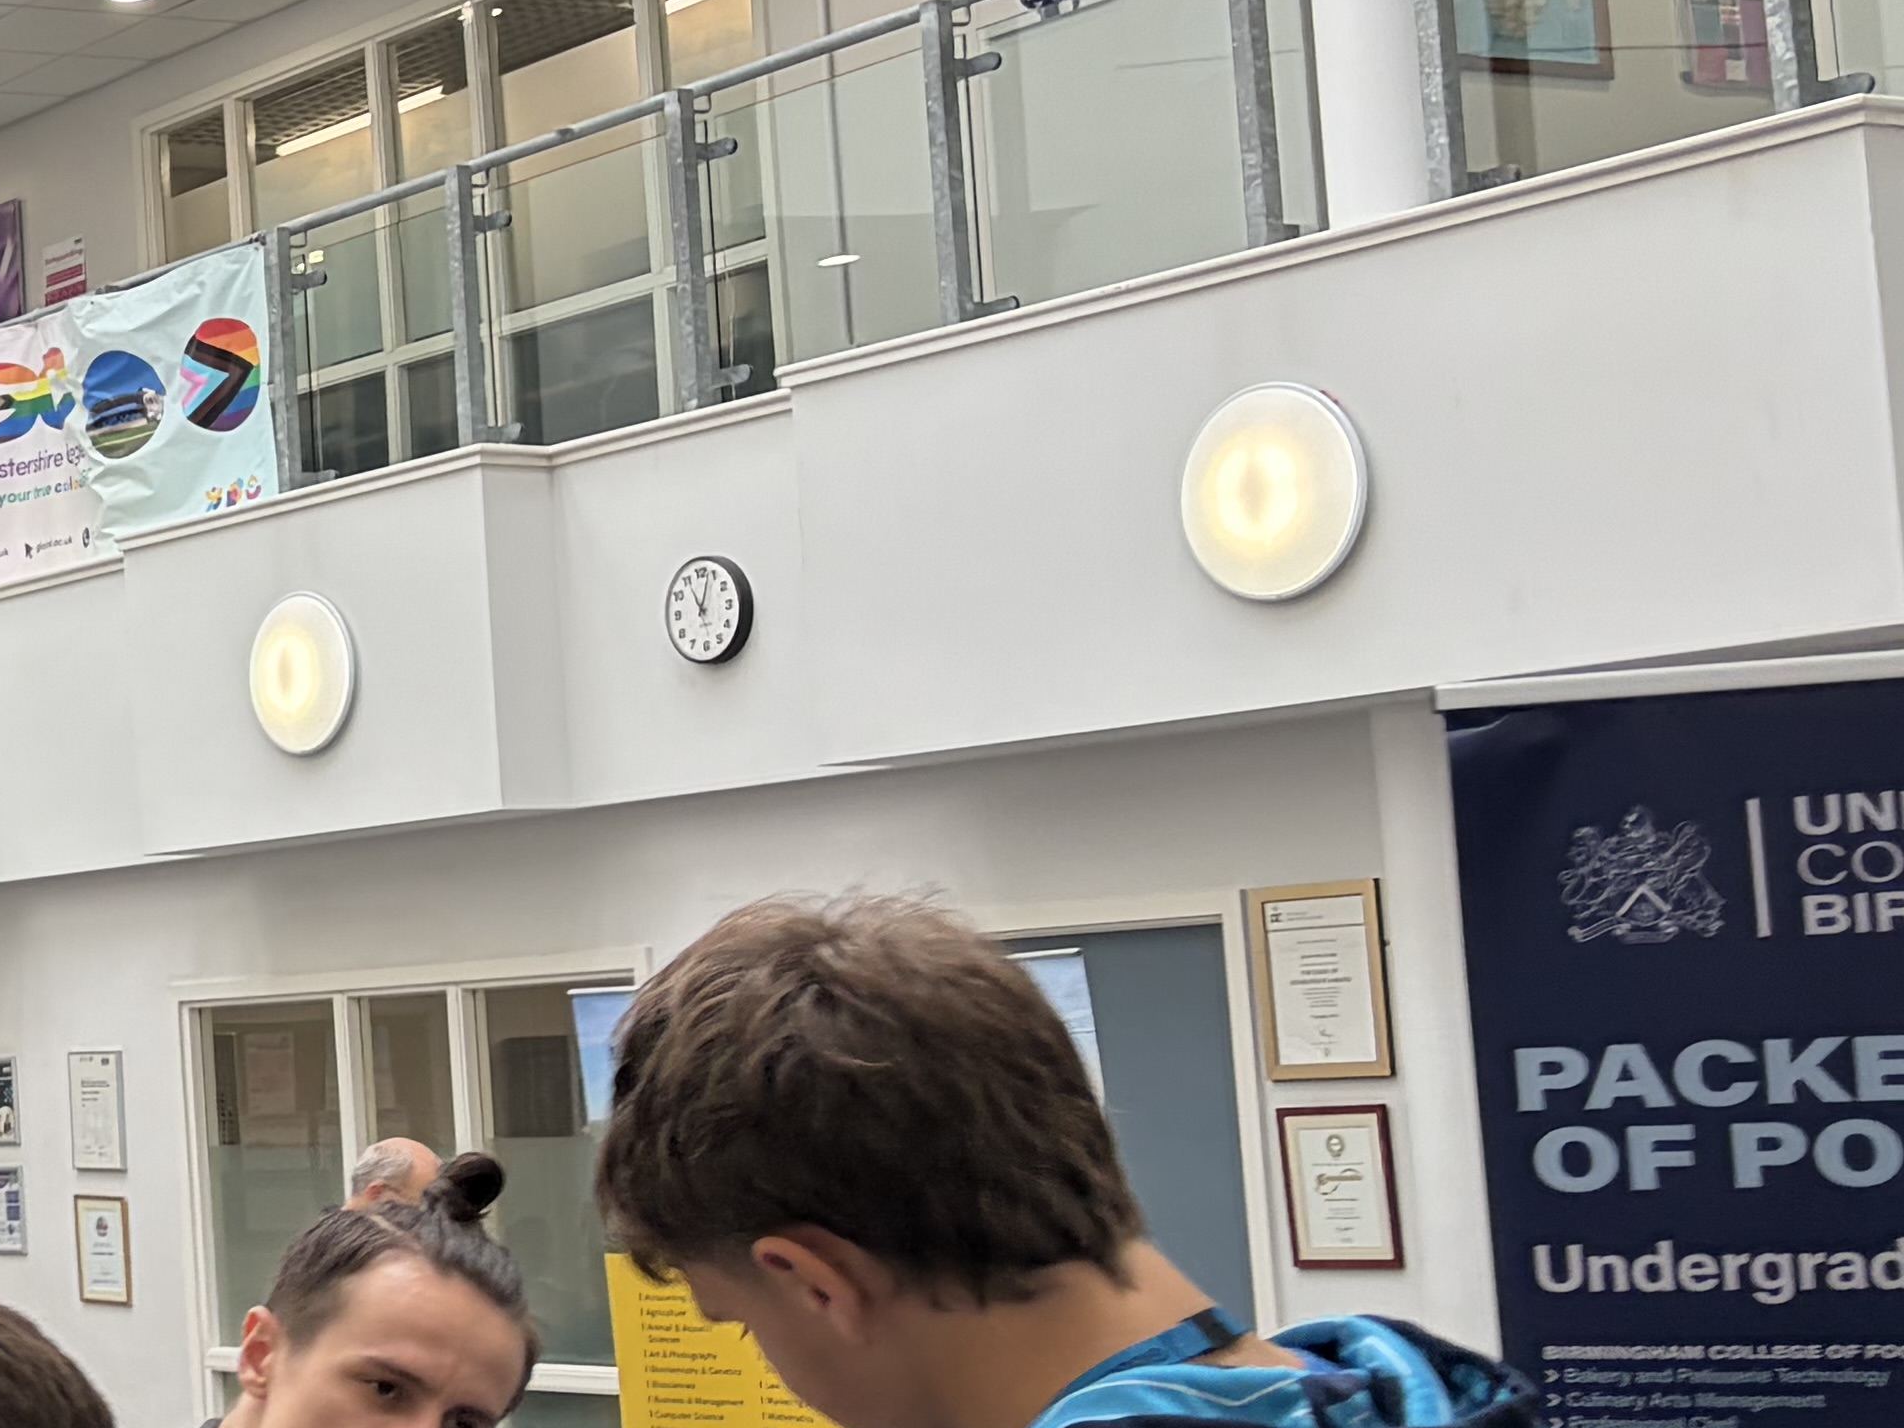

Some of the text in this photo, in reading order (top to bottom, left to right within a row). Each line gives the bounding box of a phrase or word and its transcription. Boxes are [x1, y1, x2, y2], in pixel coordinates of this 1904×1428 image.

[695, 567, 707, 579] 12
[712, 570, 717, 580] 1
[682, 575, 692, 587] 11
[720, 581, 727, 592] 2
[673, 590, 684, 601] 10
[725, 599, 733, 610] 3
[674, 611, 681, 620] 9
[724, 619, 730, 628] 4
[679, 628, 686, 639] 8
[716, 633, 723, 644] 5
[690, 639, 696, 649] 7
[703, 641, 710, 651] 6
[1532, 1118, 1904, 1193] OF PO
[1708, 1344, 1824, 1360] COLLEGE
[1825, 1345, 1862, 1360] OF
